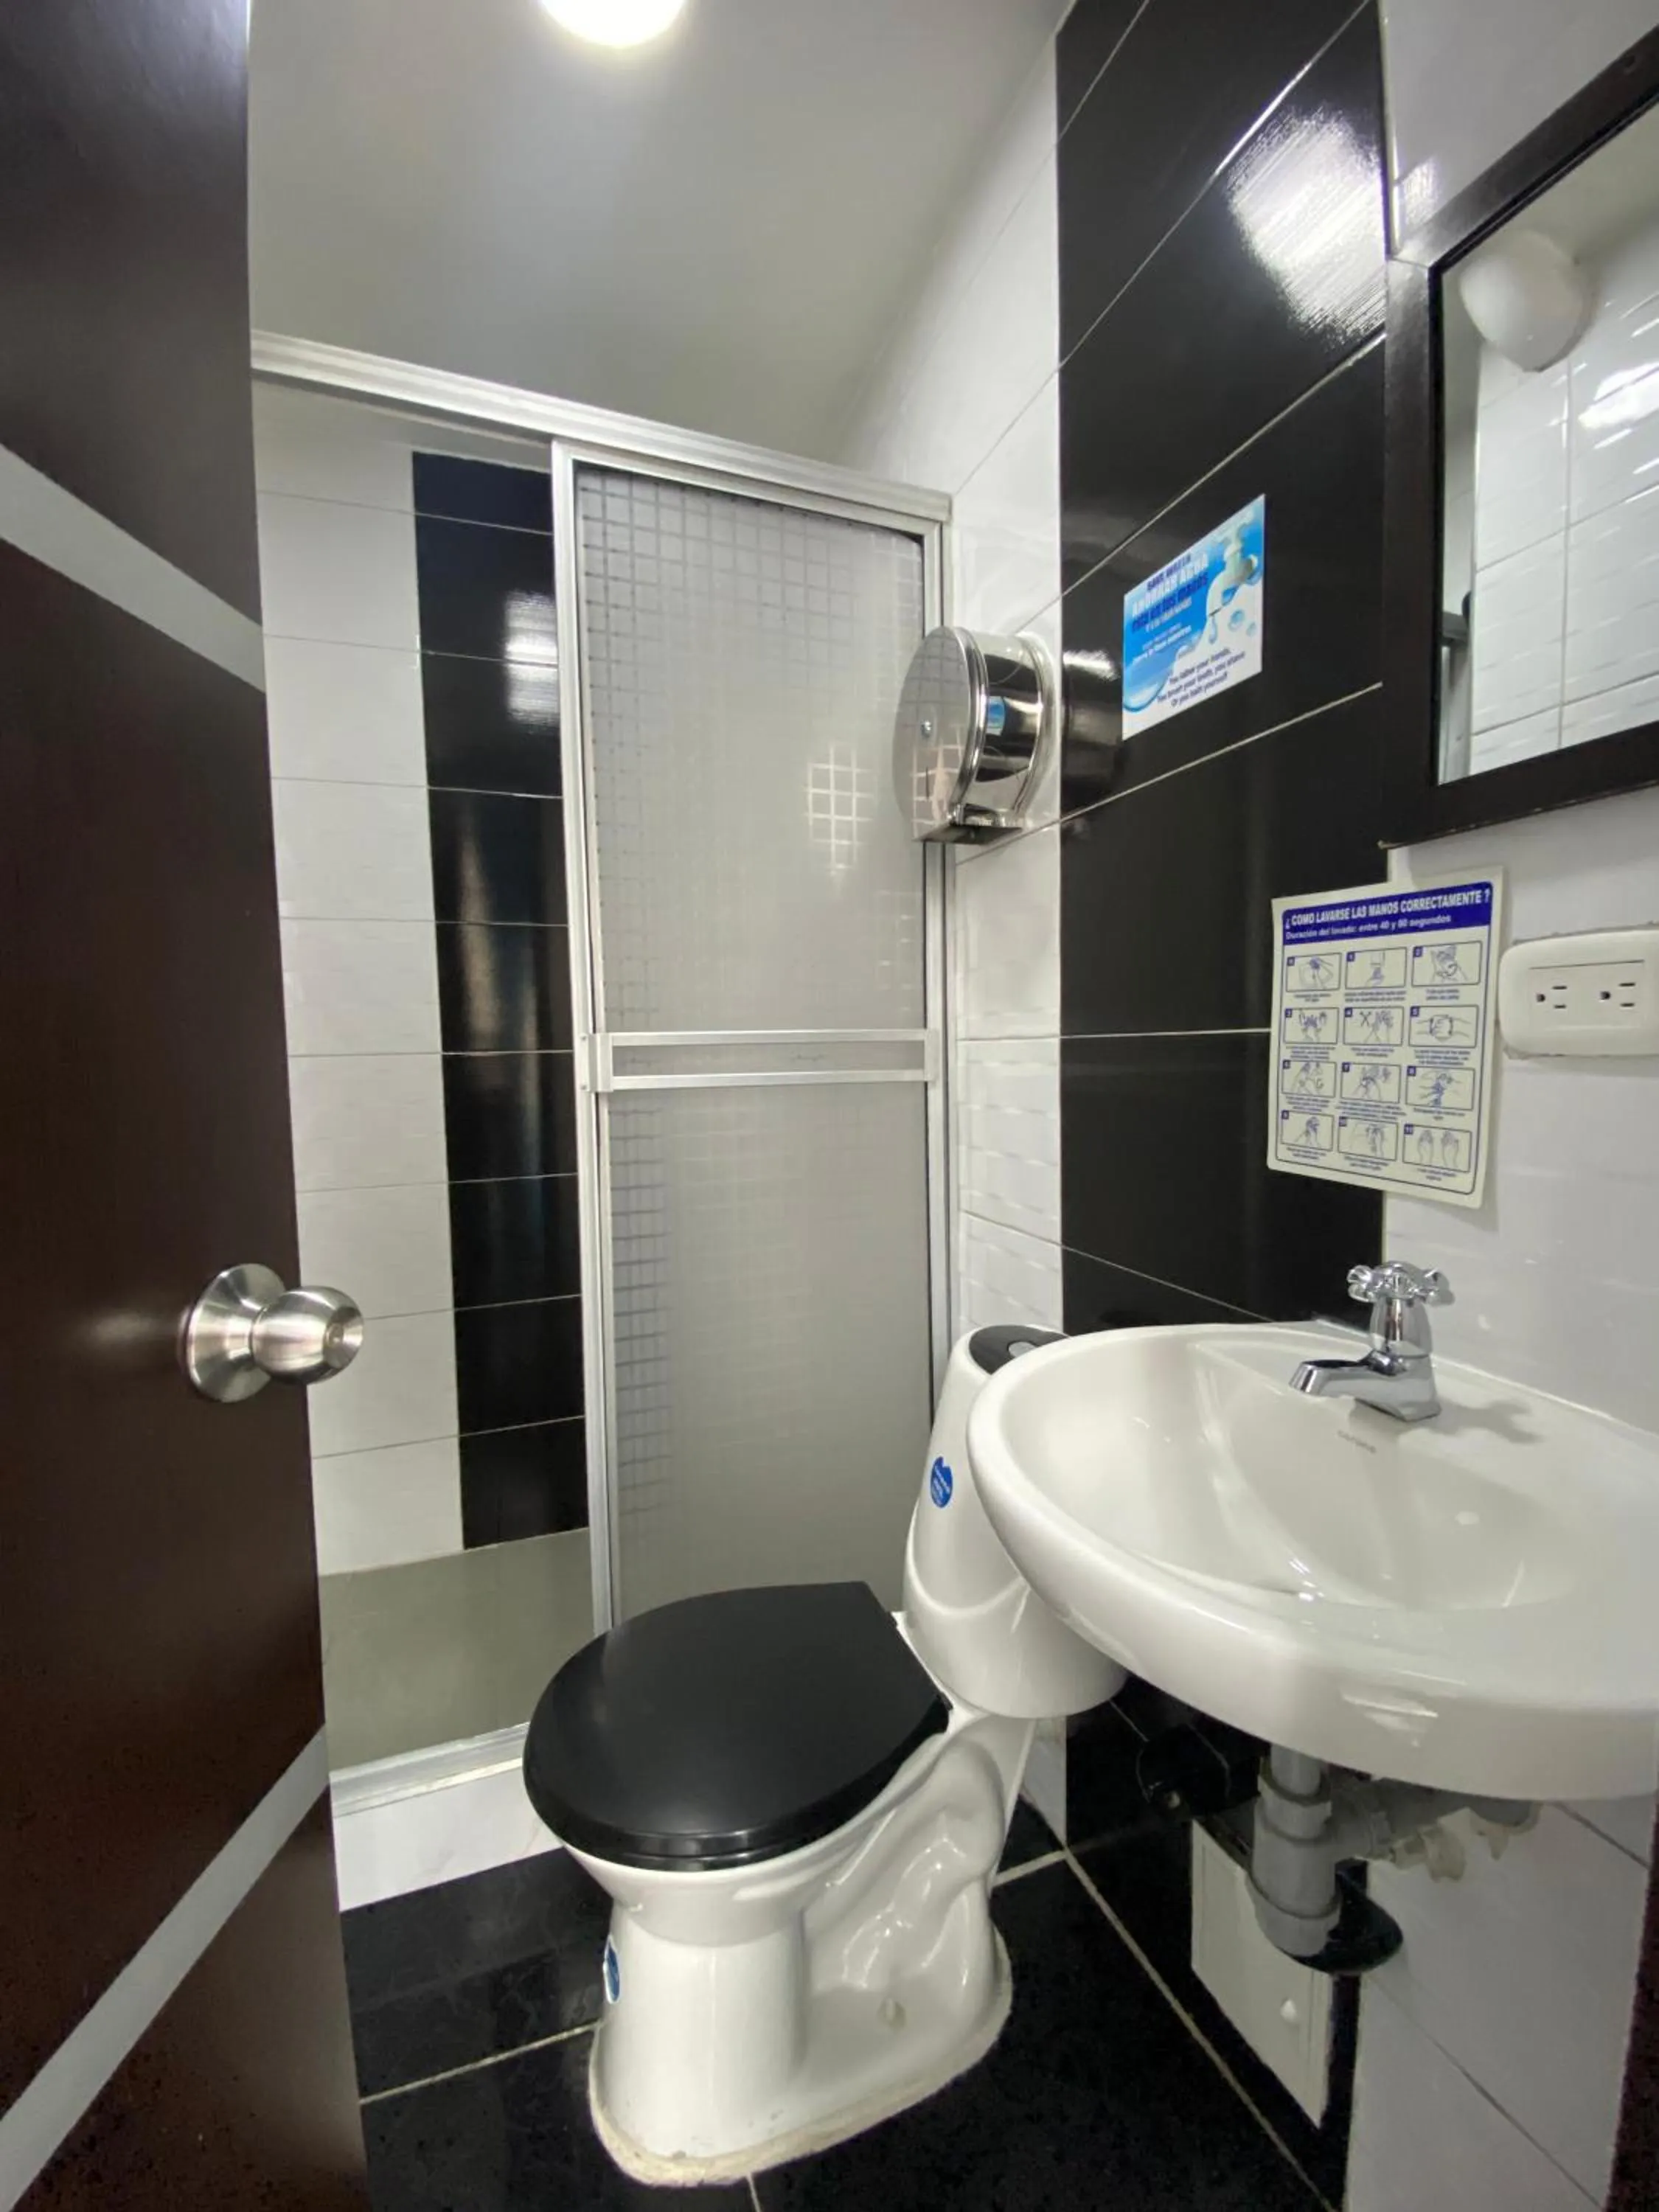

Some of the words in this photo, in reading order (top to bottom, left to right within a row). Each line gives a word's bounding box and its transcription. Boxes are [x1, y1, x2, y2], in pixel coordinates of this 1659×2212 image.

[1291, 913, 1315, 926] COMO
[1315, 908, 1350, 923] LAVARSE
[1351, 905, 1367, 919] LAS
[1368, 900, 1399, 917] MANOS
[1400, 889, 1482, 914] CORRECTAMENTE
[1358, 923, 1378, 933] entre
[1409, 914, 1451, 928] segundos
